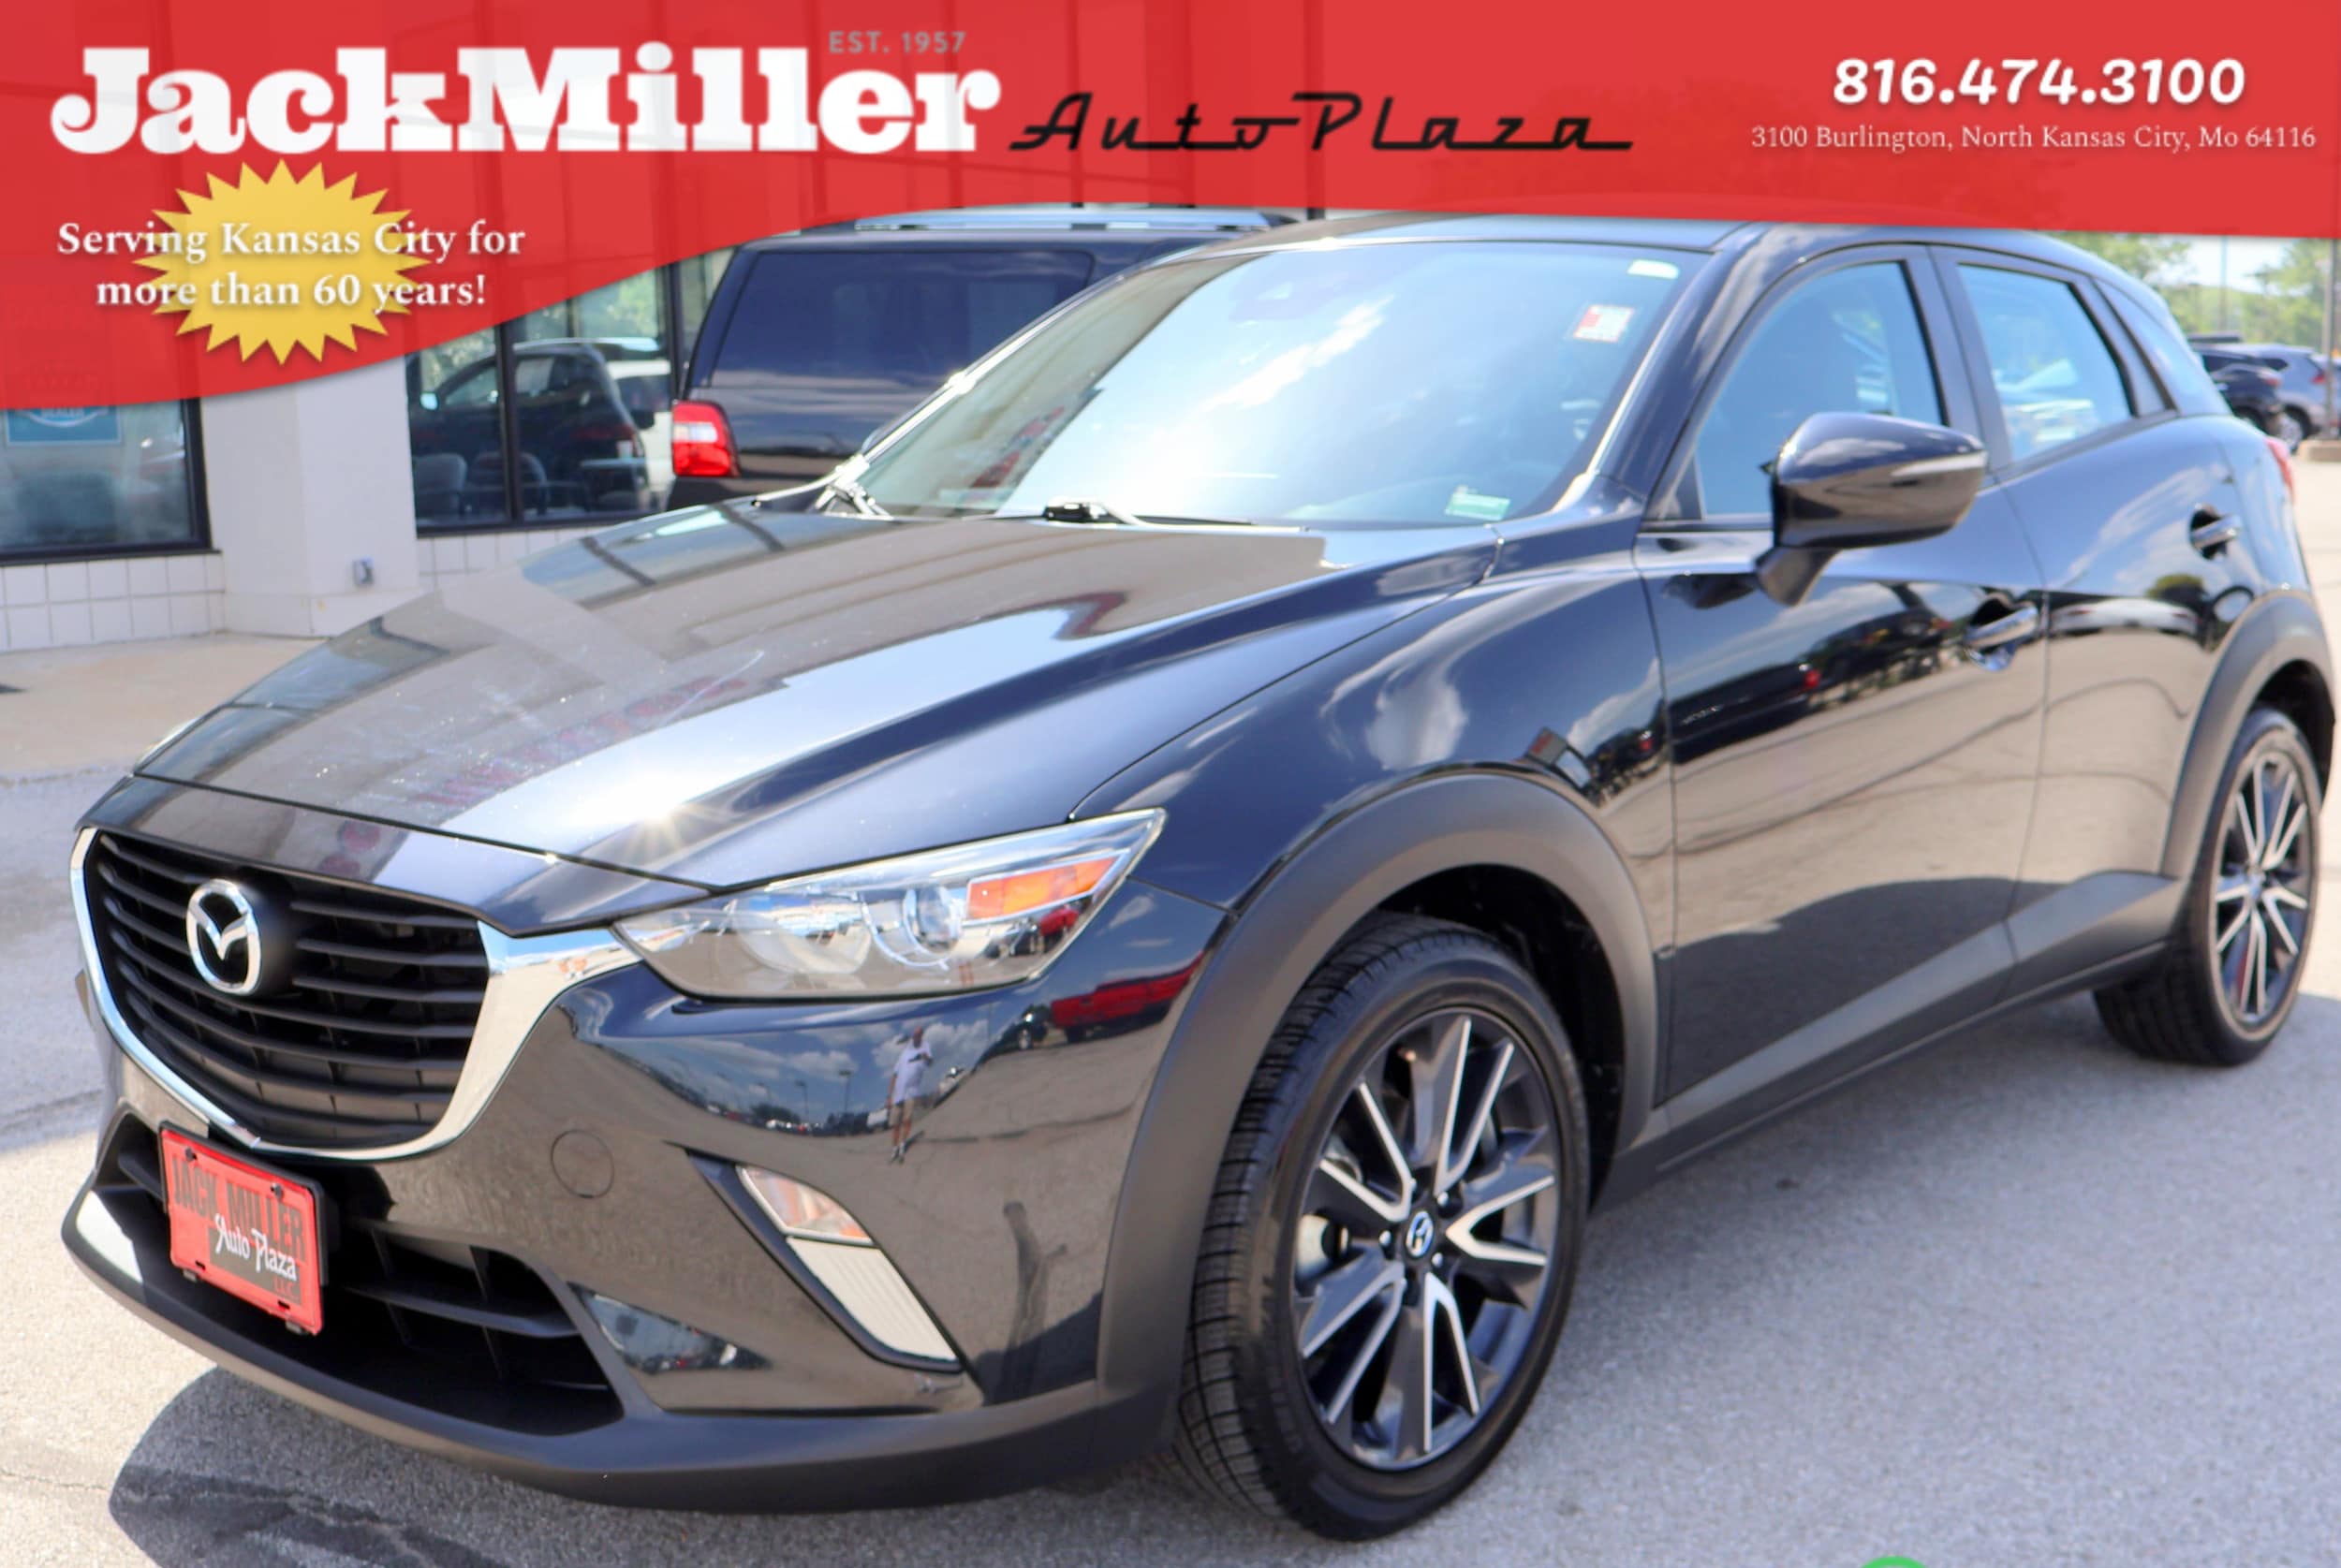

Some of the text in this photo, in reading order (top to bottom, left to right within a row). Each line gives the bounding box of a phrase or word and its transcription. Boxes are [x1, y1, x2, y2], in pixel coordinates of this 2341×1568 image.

[171, 1154, 306, 1263] JACK MILLER
[214, 1213, 298, 1282] Auto Plaza
